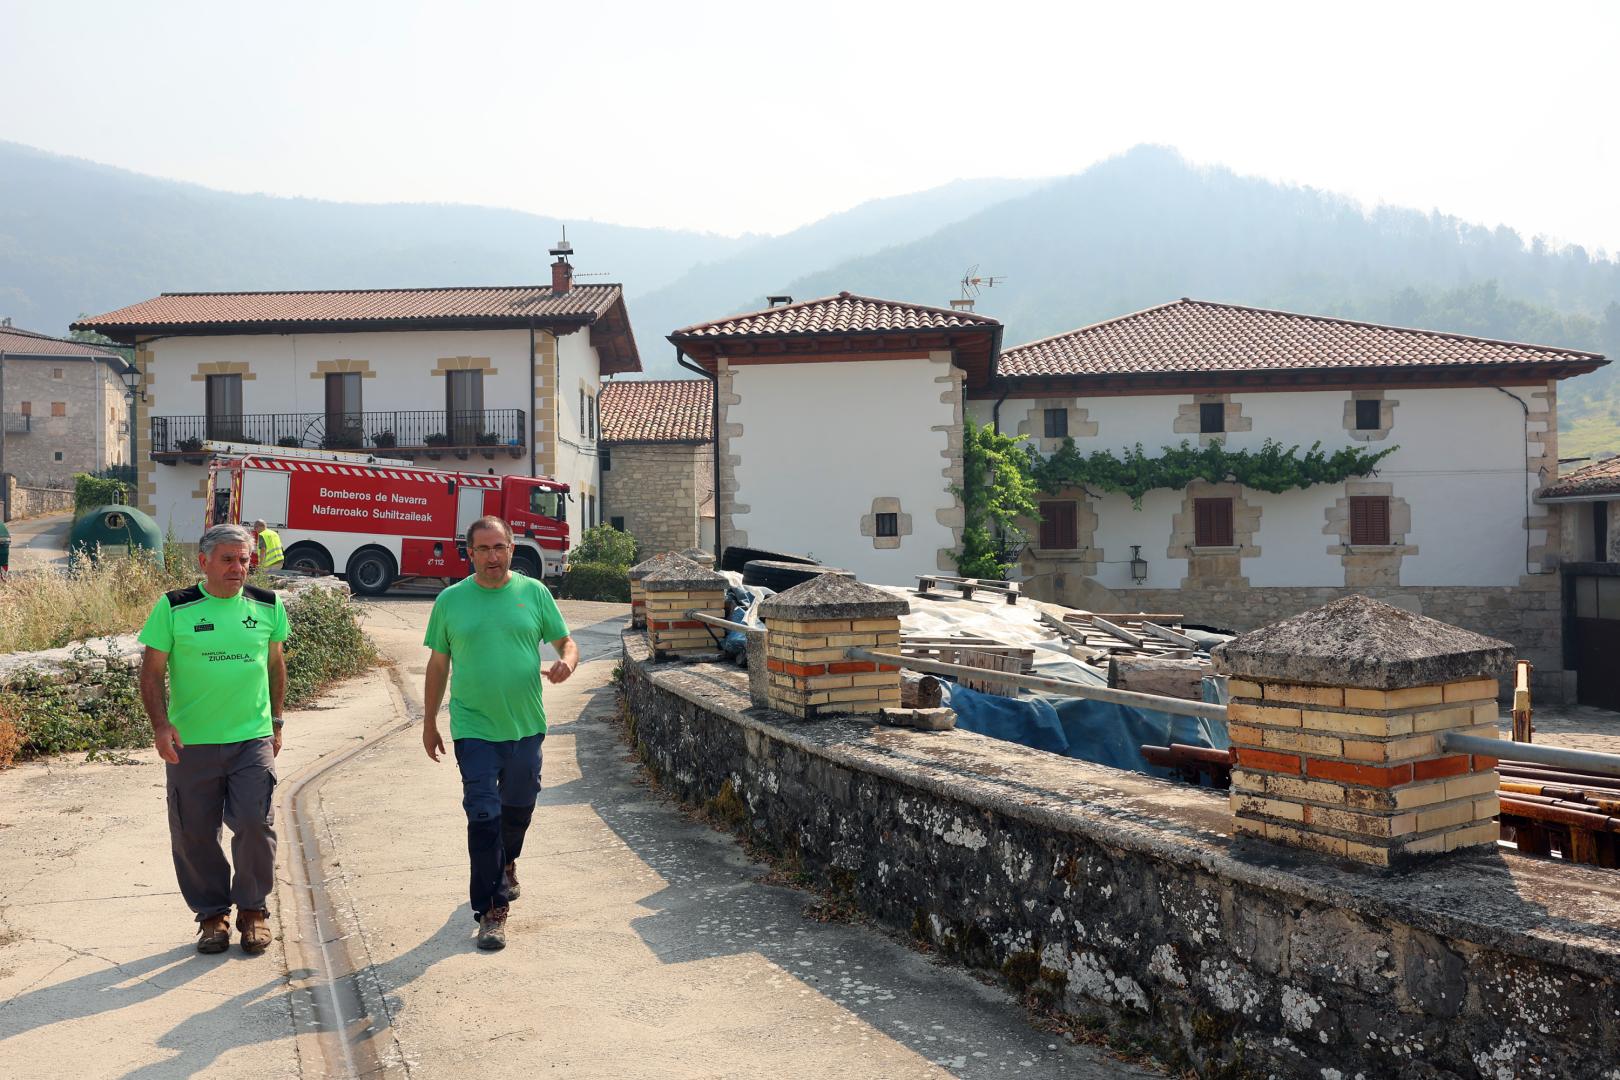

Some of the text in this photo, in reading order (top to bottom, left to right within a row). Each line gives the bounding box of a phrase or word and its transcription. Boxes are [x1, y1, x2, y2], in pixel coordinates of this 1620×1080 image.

[320, 487, 427, 505] Bomberos de Navarra
[312, 504, 433, 522] Nafarroako Suhiltzaileak
[208, 653, 250, 662] ZIUDADELA
